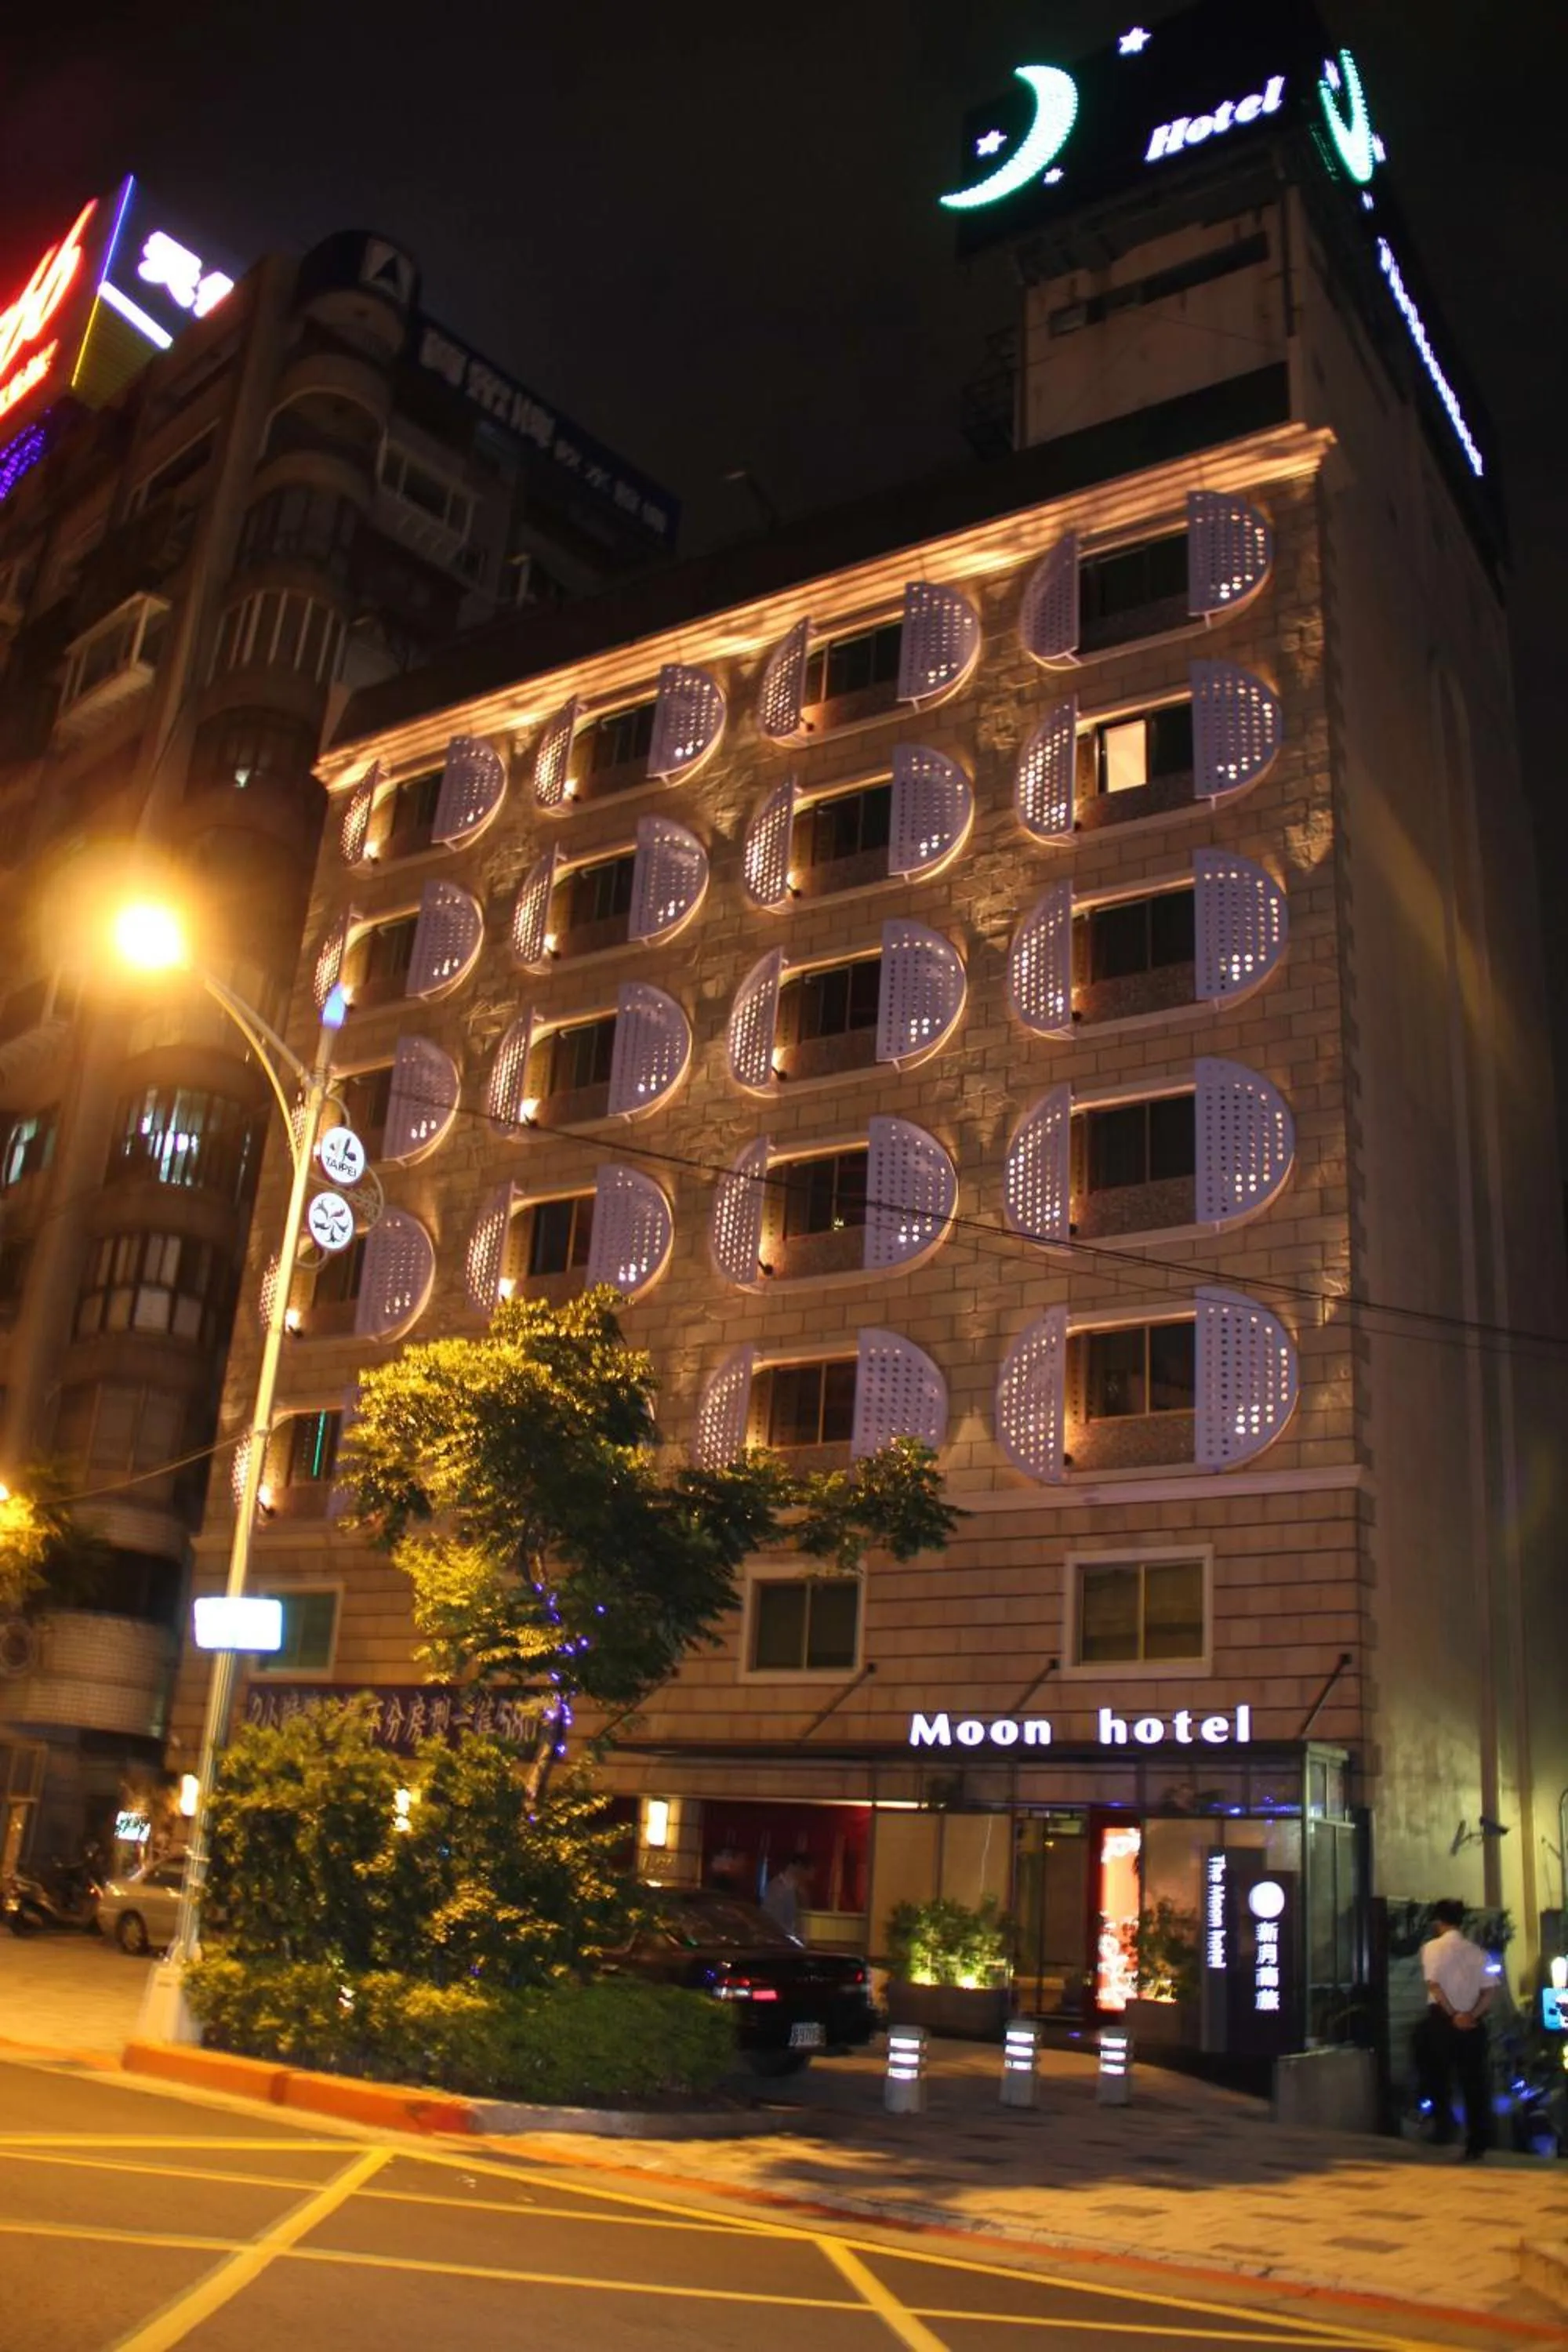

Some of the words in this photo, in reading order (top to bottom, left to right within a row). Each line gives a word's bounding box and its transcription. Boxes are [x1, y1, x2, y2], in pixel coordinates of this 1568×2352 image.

[1145, 75, 1285, 162] Hotel
[326, 1157, 357, 1177] TAIPEI
[909, 1711, 1052, 1747] Moon
[1098, 1705, 1251, 1744] hotel
[1207, 1854, 1226, 1882] The
[1207, 1885, 1225, 1928] Moon
[1207, 1929, 1227, 1969] hotel
